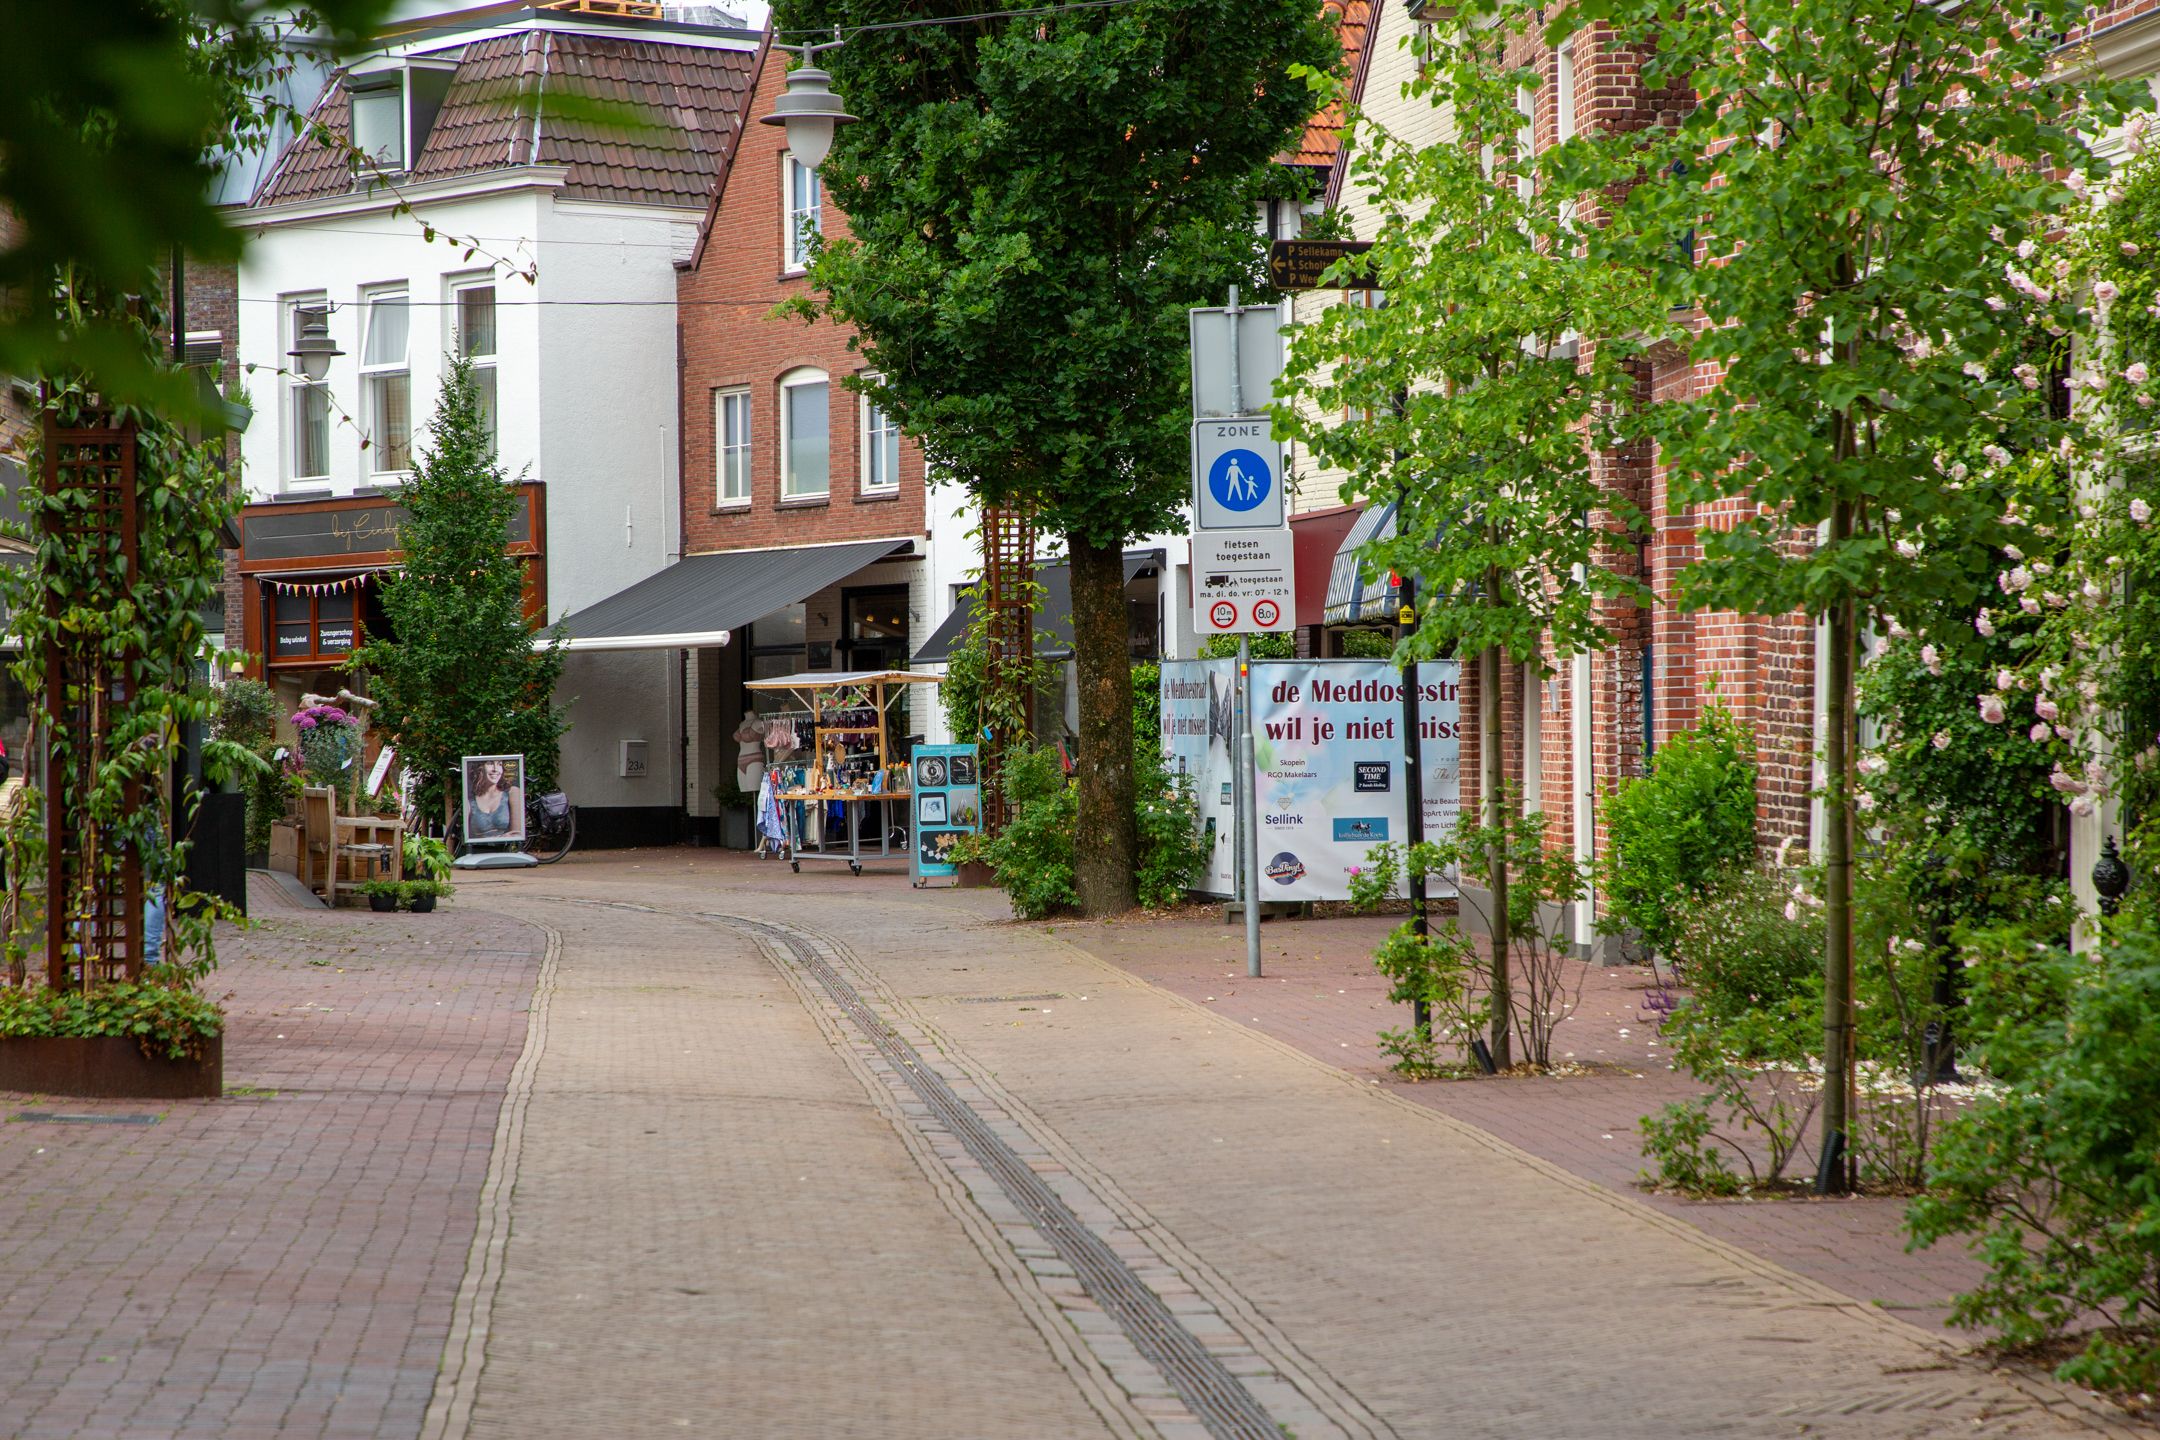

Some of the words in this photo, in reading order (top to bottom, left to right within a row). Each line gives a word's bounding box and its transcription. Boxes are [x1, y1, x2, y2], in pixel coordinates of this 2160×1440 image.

[1288, 245, 1295, 256] P
[1298, 245, 1343, 257] Sellekamp
[1290, 273, 1296, 284] P
[1217, 425, 1260, 437] ZONE
[1224, 541, 1259, 549] fietsen
[1216, 552, 1271, 562] toegestaan
[1240, 576, 1283, 584] toegestaan
[1216, 590, 1226, 598] di.
[280, 637, 291, 645] Baby
[1272, 680, 1300, 703] de
[1265, 717, 1301, 740] wil
[1312, 717, 1334, 745] je
[1346, 716, 1395, 739] niet
[628, 761, 645, 771] 23A
[1280, 759, 1305, 767] Skopein
[1265, 814, 1303, 824] Sellink
[1424, 810, 1442, 818] opArt
